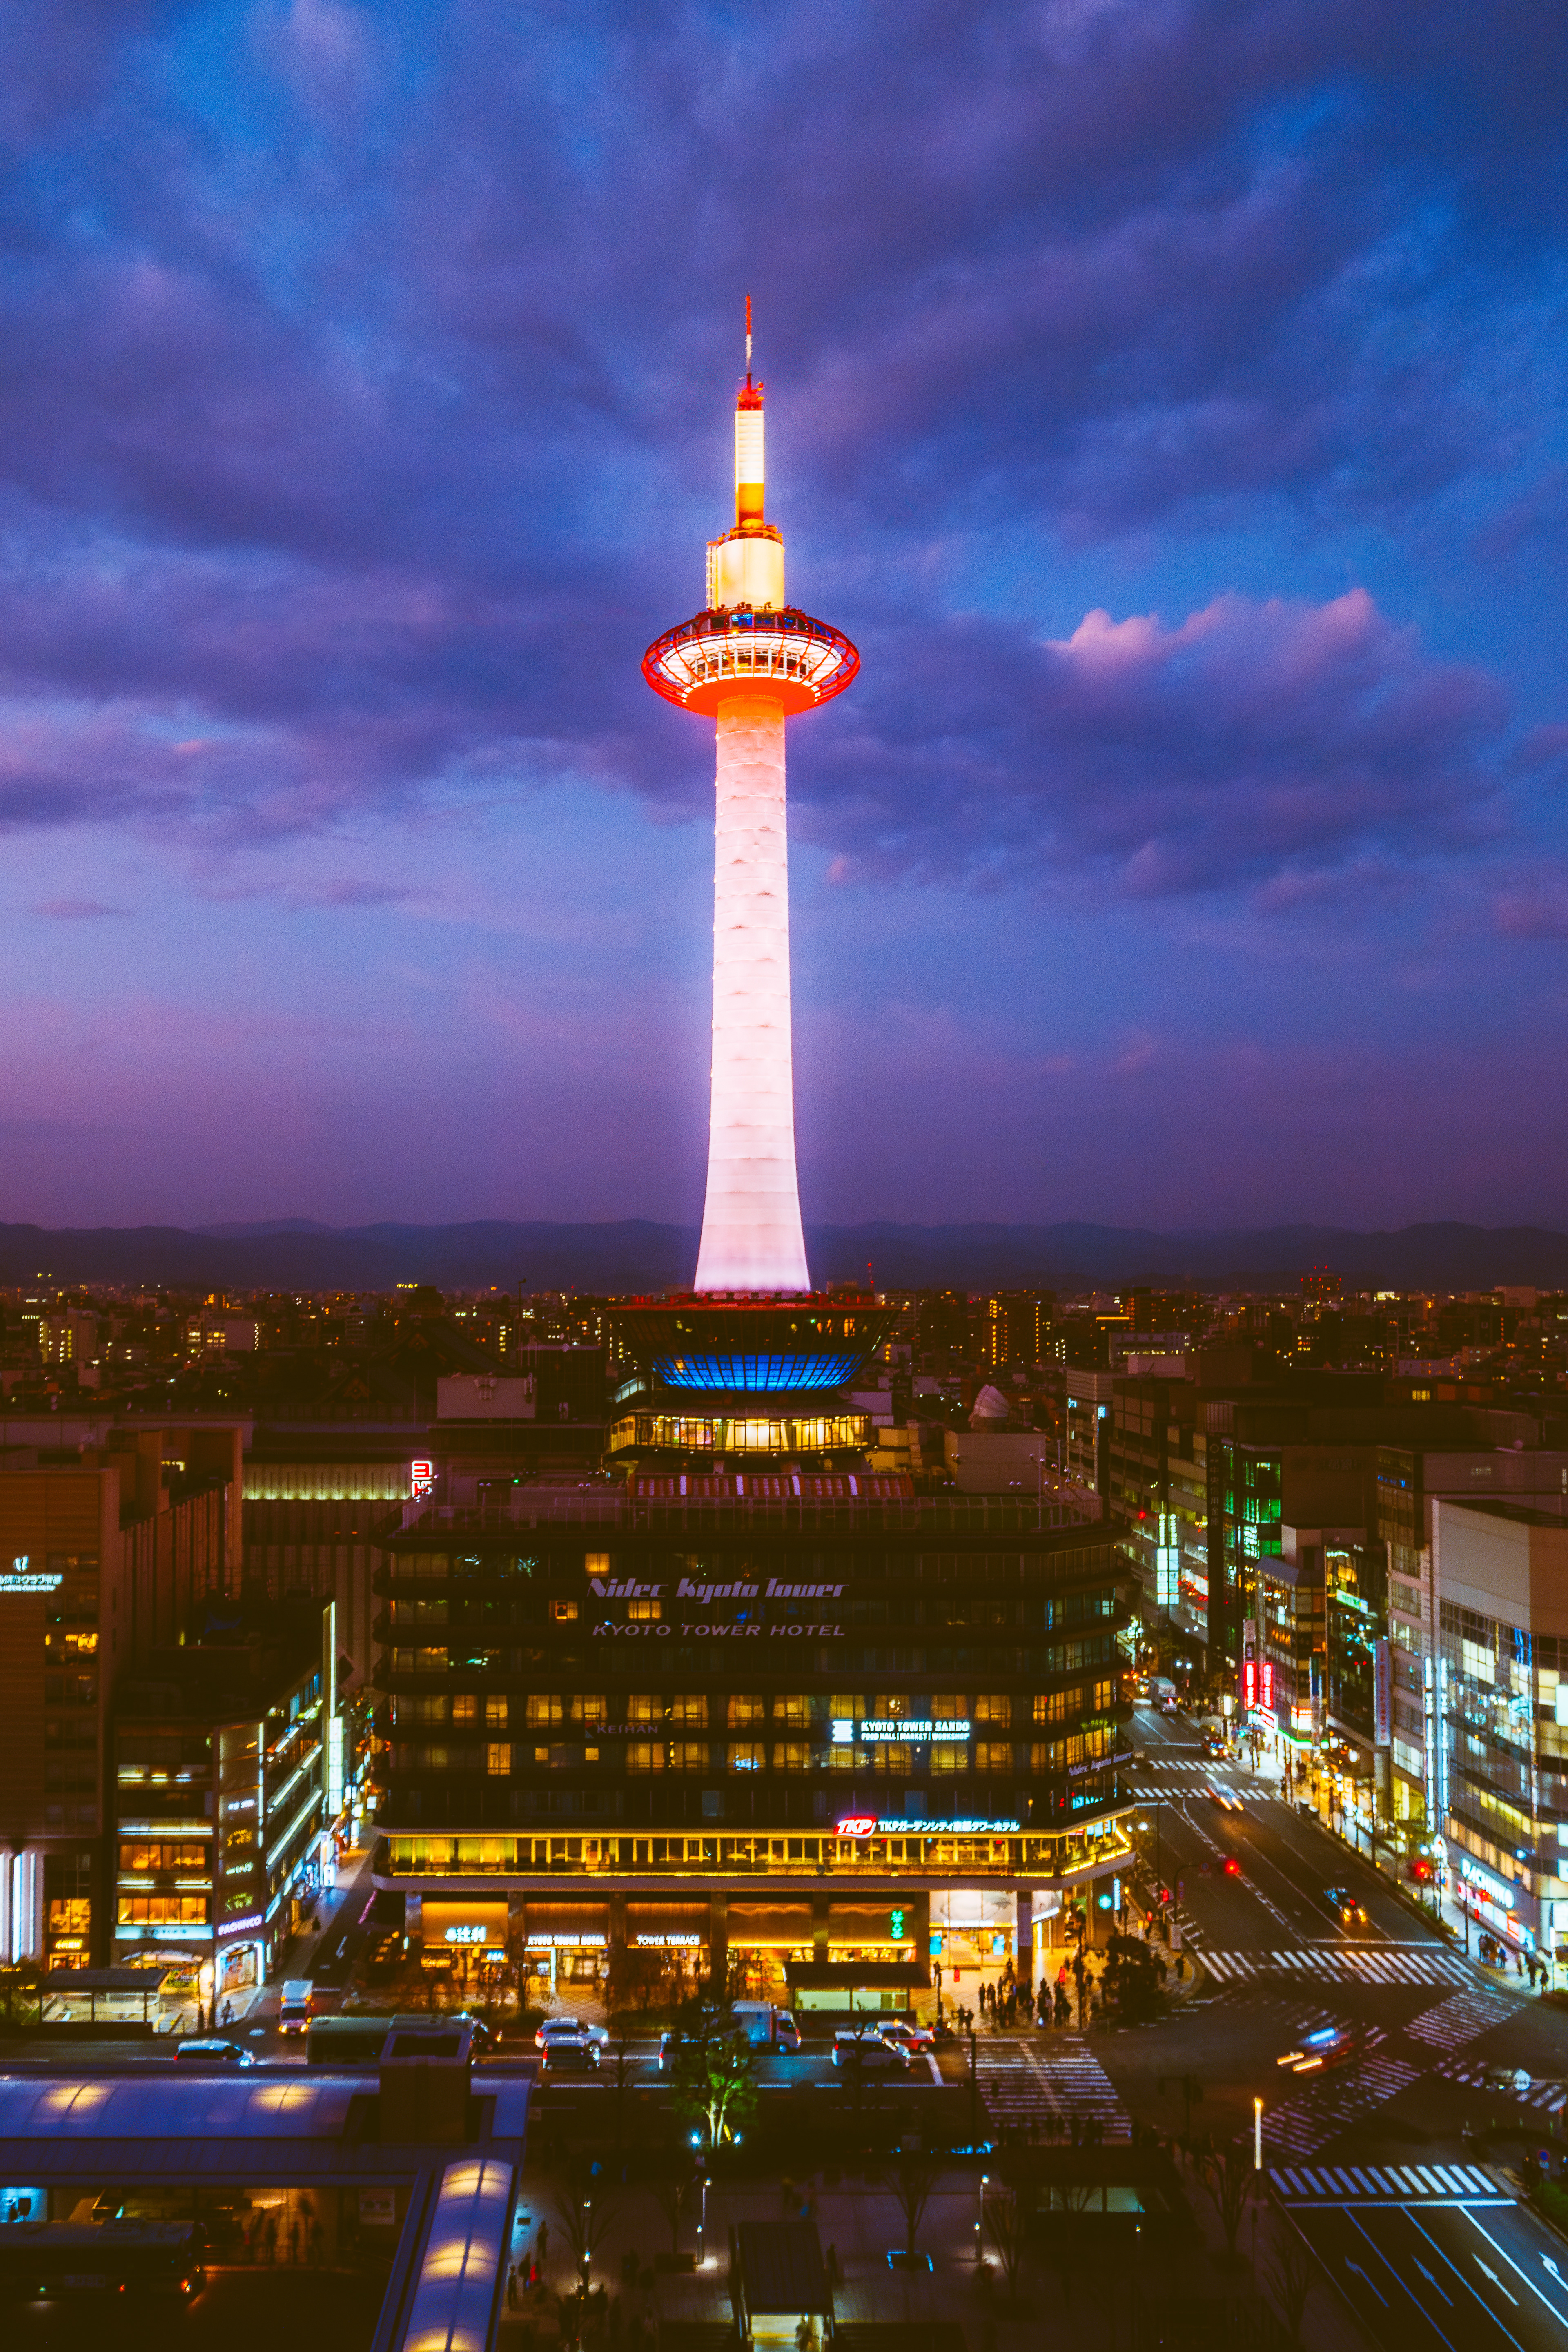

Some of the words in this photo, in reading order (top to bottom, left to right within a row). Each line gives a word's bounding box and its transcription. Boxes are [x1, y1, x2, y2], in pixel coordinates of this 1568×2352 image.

[587, 1578, 668, 1597] Nidec
[676, 1578, 759, 1604] Kyoto
[765, 1578, 849, 1597] Tower
[592, 1625, 671, 1636] KYOTO
[682, 1625, 761, 1636] TOWER
[770, 1625, 845, 1636] HOTEL
[597, 1724, 658, 1734] KEIHAN
[861, 1721, 894, 1732] KYOTO
[897, 1721, 932, 1732] TOWER
[935, 1721, 969, 1732] SANDO
[837, 1820, 872, 1833] TKP
[878, 1820, 1020, 1832] TKPガーデンシティ京都タワーホテル
[1462, 1858, 1514, 1909] PACHINKO
[636, 1935, 665, 1946] TOWER
[666, 1935, 700, 1946] TERRACE
